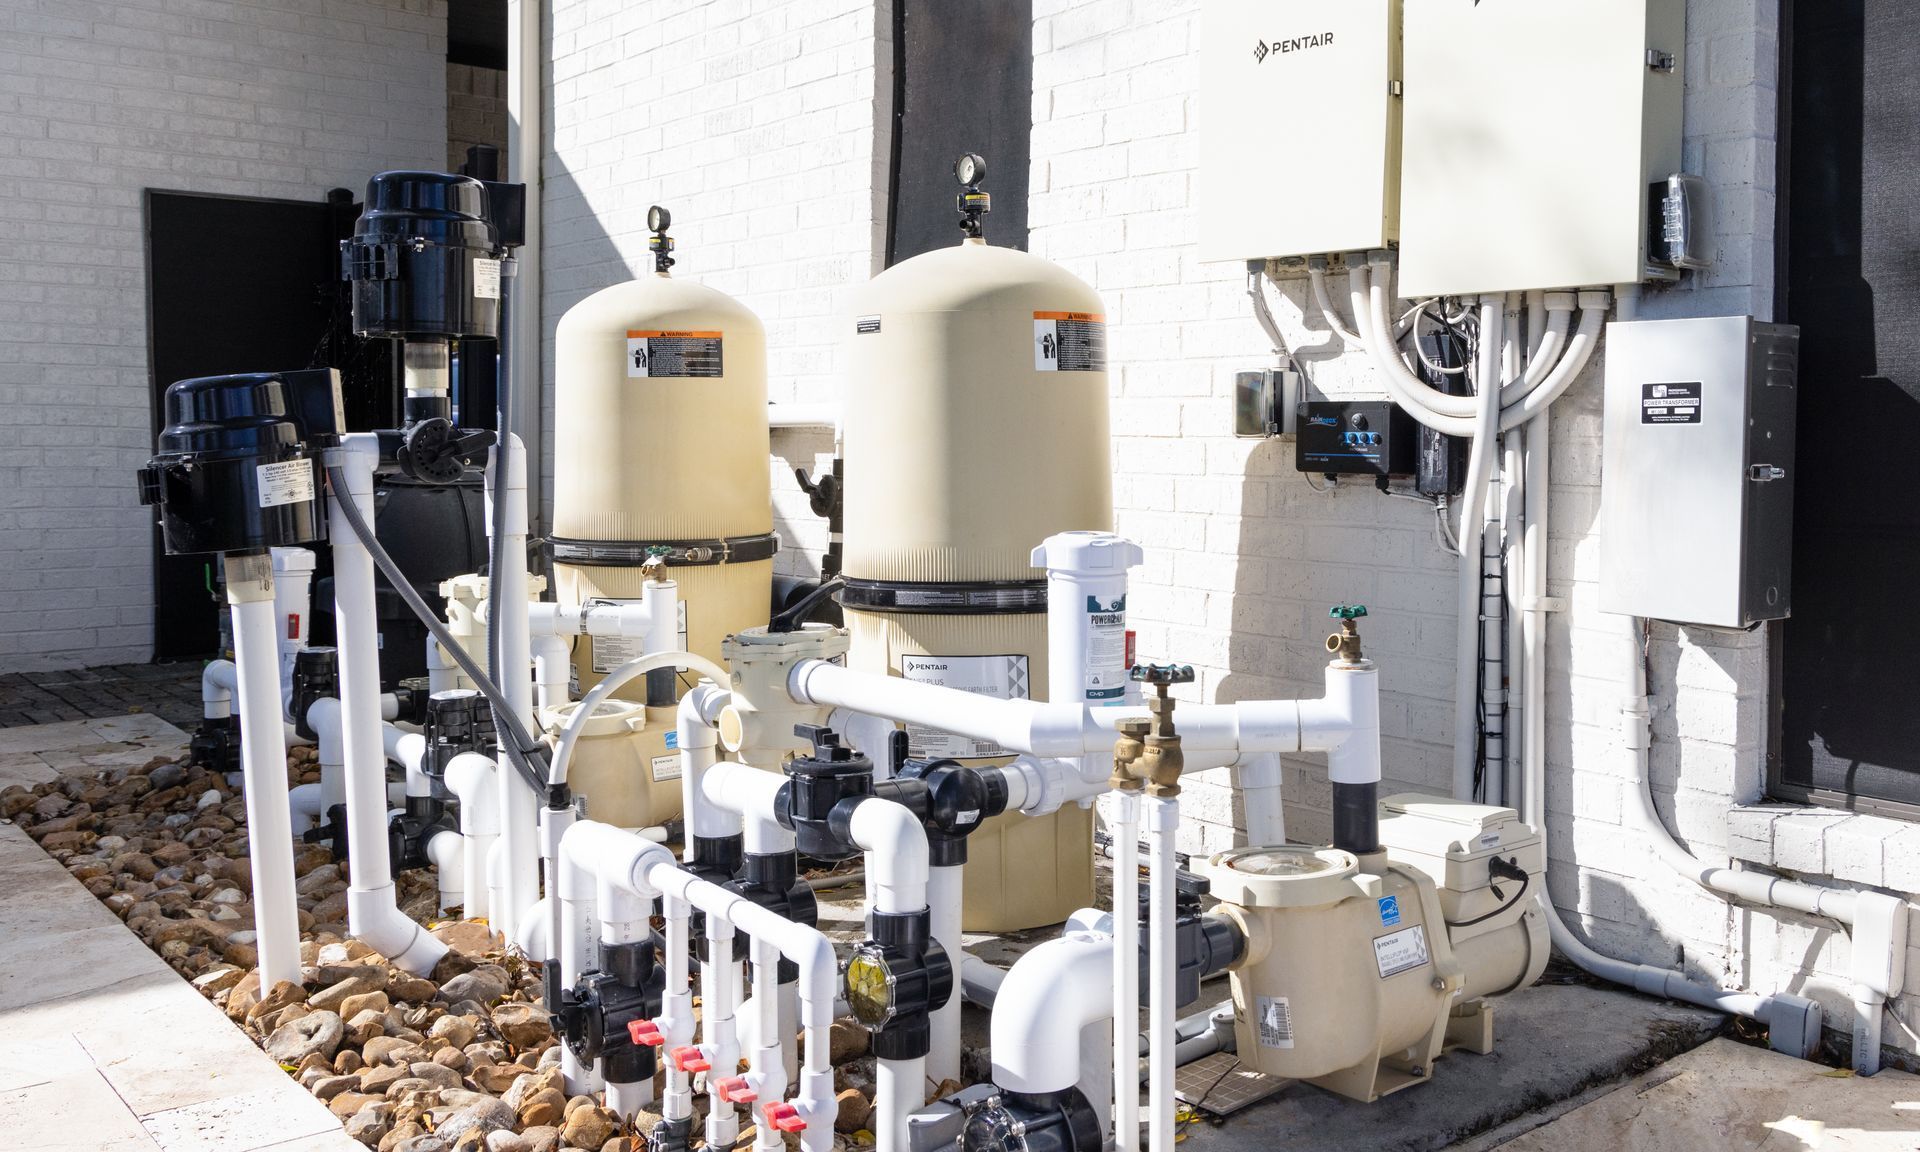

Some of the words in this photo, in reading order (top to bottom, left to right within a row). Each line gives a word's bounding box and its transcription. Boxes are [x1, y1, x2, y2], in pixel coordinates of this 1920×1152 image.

[1272, 32, 1334, 55] PENTAIR
[926, 678, 944, 686] PLUS
[967, 686, 982, 694] EARTH
[983, 685, 998, 693] FILTER
[1381, 938, 1398, 946] PENTAIR
